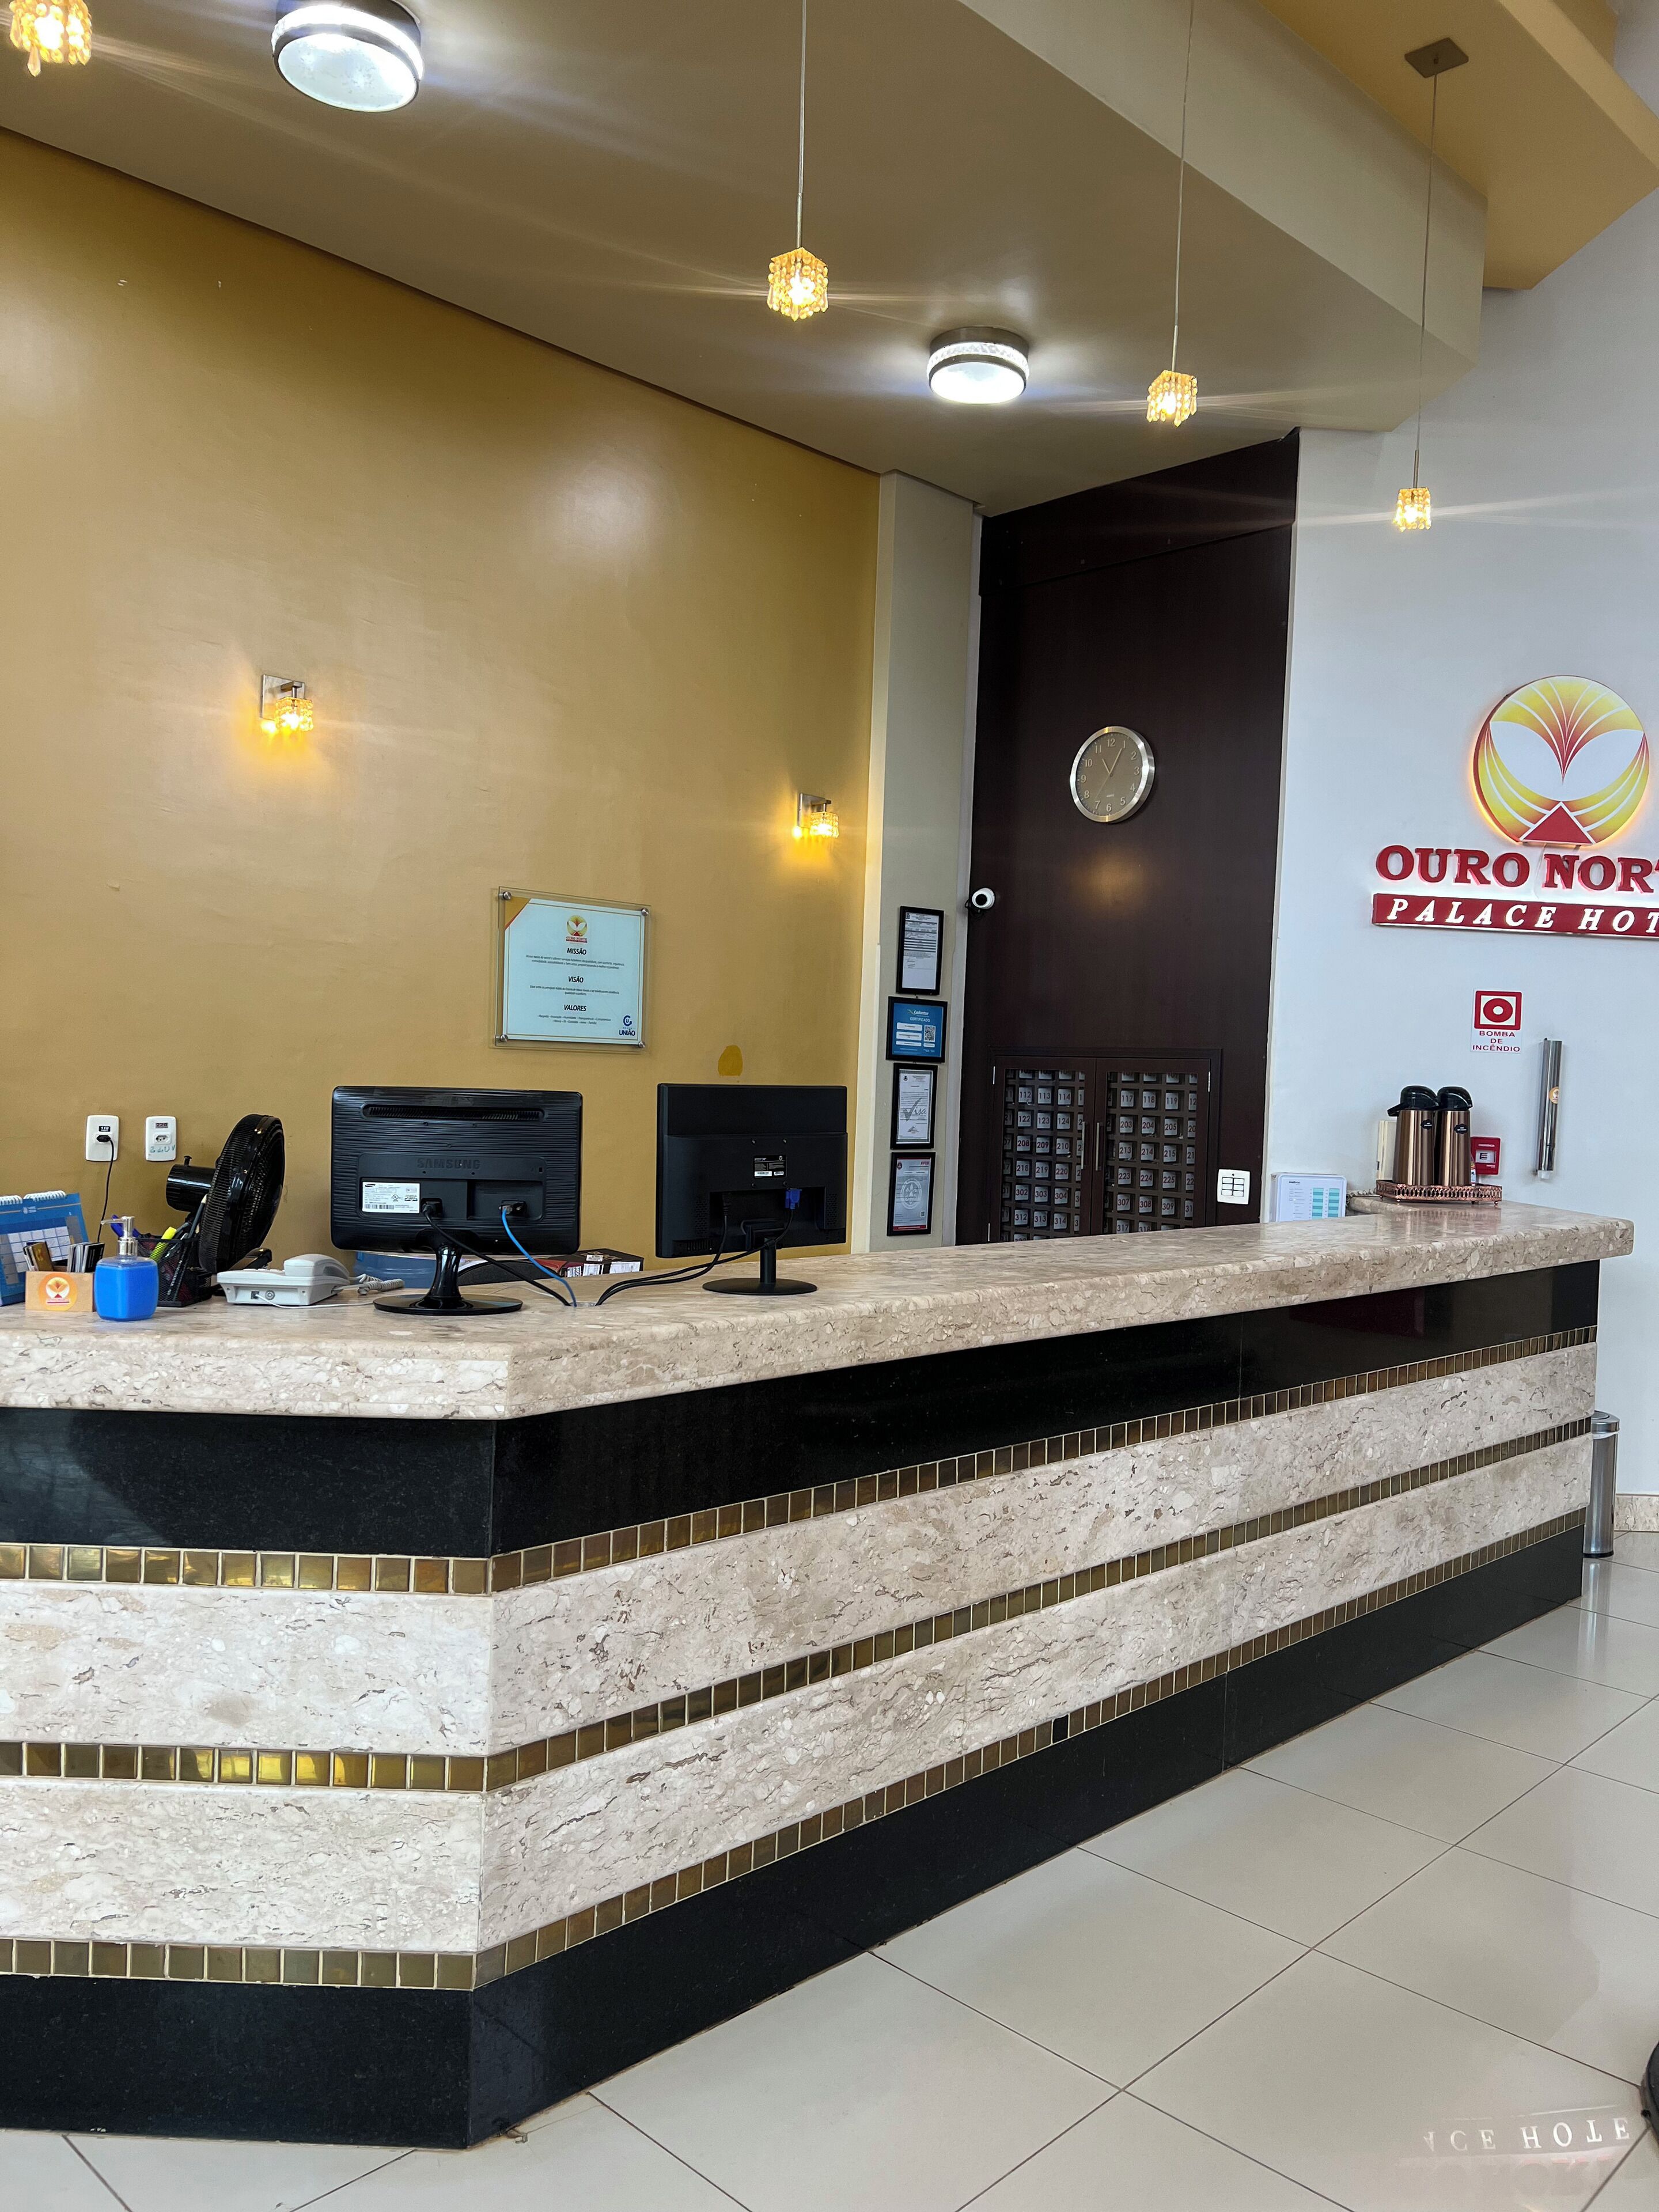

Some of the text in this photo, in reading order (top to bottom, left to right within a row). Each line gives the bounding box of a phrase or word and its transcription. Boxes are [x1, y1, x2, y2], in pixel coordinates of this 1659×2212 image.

[1096, 745, 1102, 753] 11
[1131, 752, 1137, 760] 2
[1085, 759, 1092, 767] 10
[1134, 767, 1139, 775] 3
[1081, 775, 1086, 783] 9
[1130, 783, 1135, 791] 4
[1096, 801, 1100, 809] 7
[1120, 797, 1126, 805] 5
[1107, 804, 1111, 812] 6
[1376, 845, 1659, 894] OURO NOR
[1387, 899, 1556, 929] PALACE
[417, 1158, 480, 1169] SAMSUNG
